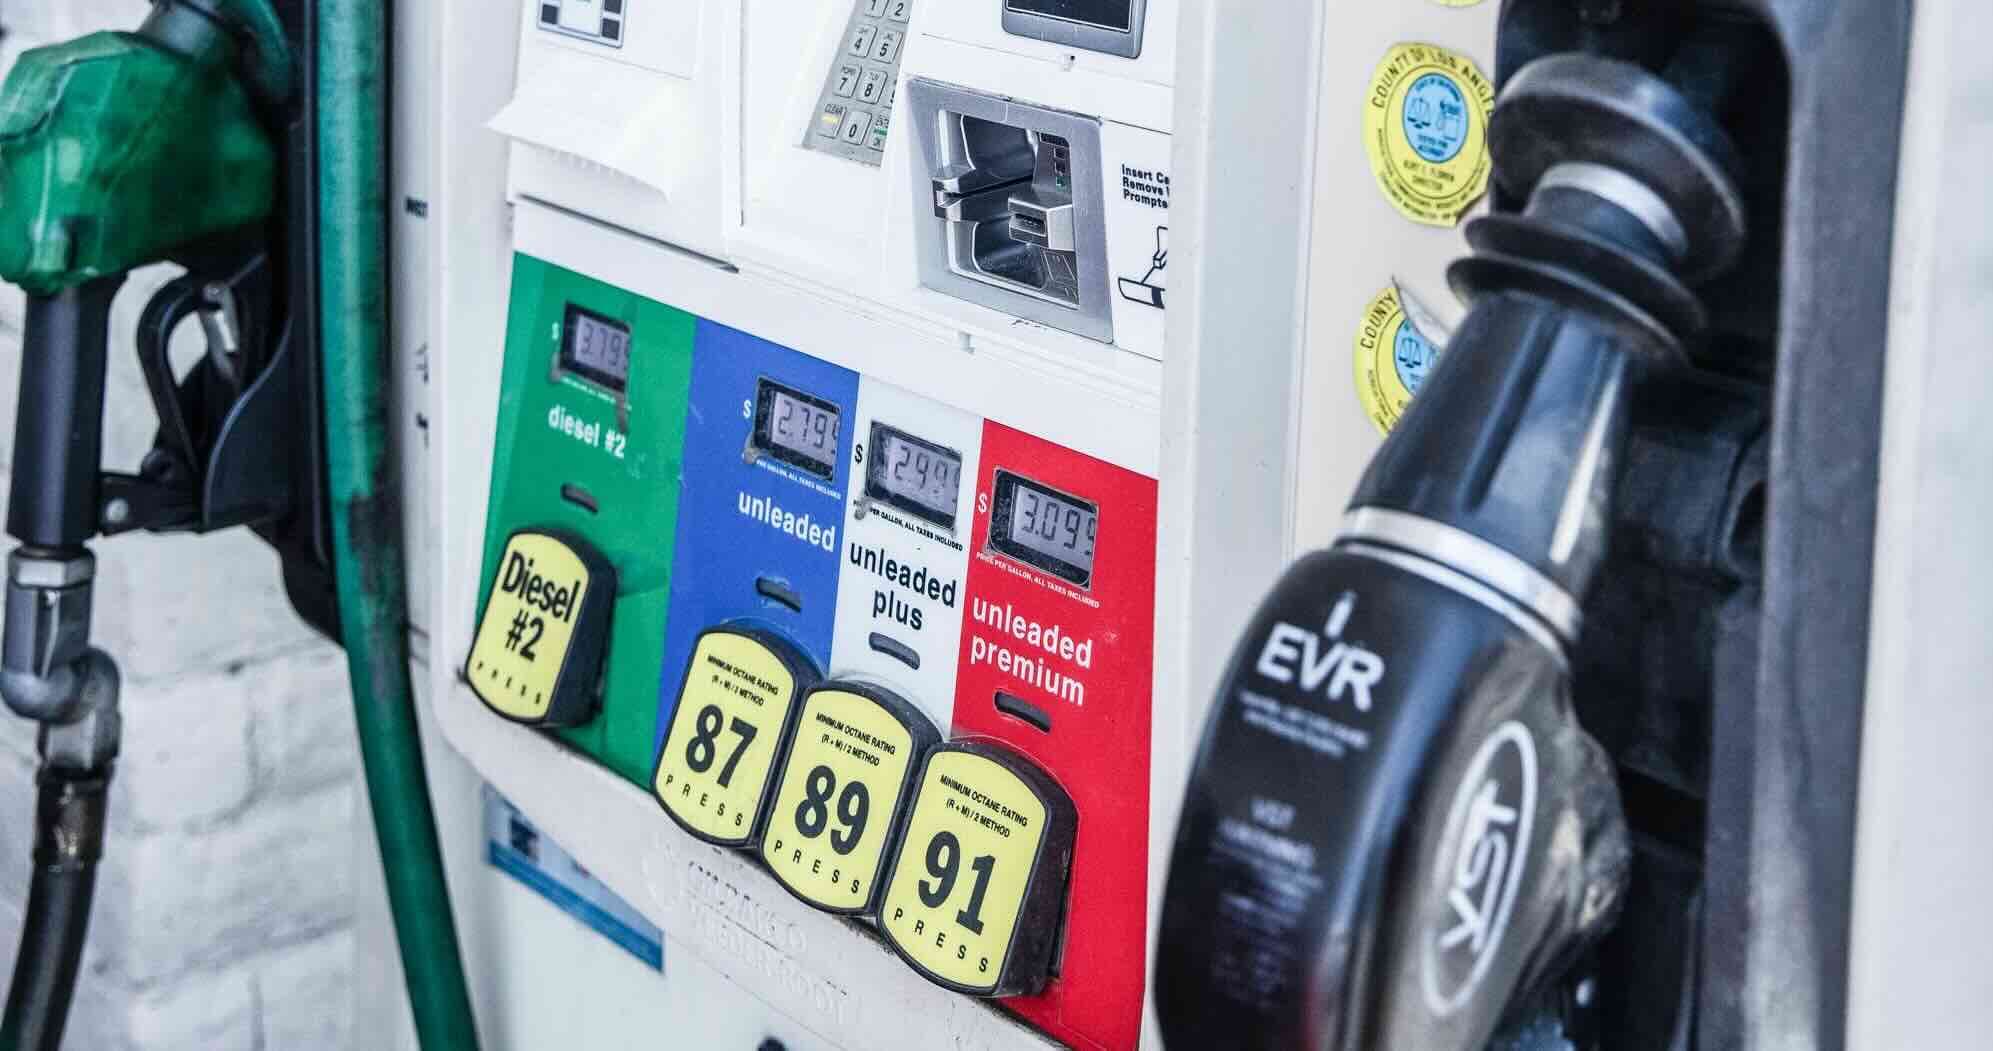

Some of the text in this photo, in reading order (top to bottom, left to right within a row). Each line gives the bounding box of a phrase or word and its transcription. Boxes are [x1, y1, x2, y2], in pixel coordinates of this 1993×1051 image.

[894, 2, 905, 17] 2
[853, 37, 889, 57] 4 5
[839, 76, 848, 92] 7
[864, 82, 874, 98] 8
[848, 123, 858, 139] 0
[1121, 163, 1153, 182] Insert
[1122, 175, 1164, 196] Remove
[1123, 188, 1169, 209] Prompts
[1359, 292, 1397, 350] COUNTY
[547, 403, 627, 459] diesel #2
[743, 399, 753, 420] $
[854, 443, 864, 465] $
[737, 491, 837, 553] unleaded
[977, 491, 988, 515] $
[904, 521, 916, 533] ALL
[916, 525, 934, 541] TAXES
[934, 533, 964, 553] INCLUDED
[501, 549, 581, 624] Diesel
[849, 541, 958, 610] unleaded
[1033, 576, 1047, 587] ALL
[1047, 580, 1067, 596] TAXES
[1067, 589, 1101, 610] INCLUDED
[871, 588, 924, 632] plus
[505, 608, 546, 663] #2
[971, 595, 1094, 670] unleaded
[732, 667, 757, 685] OCTANE
[757, 678, 779, 696] RATING
[969, 633, 1086, 707] premium
[1255, 620, 1386, 713] EVR
[739, 687, 766, 707] METHOD
[685, 703, 759, 790] 87
[816, 711, 897, 756] MINIMUM OCTANE RATING
[851, 746, 881, 767] METHOD
[665, 773, 745, 828] PRESS
[793, 764, 871, 857] 89
[940, 773, 1029, 828] MINIMUM OCTANE RATING
[979, 814, 1011, 839] METHOD
[773, 838, 861, 895] PRESS
[917, 830, 997, 938] 91
[892, 906, 990, 974] PRESS
